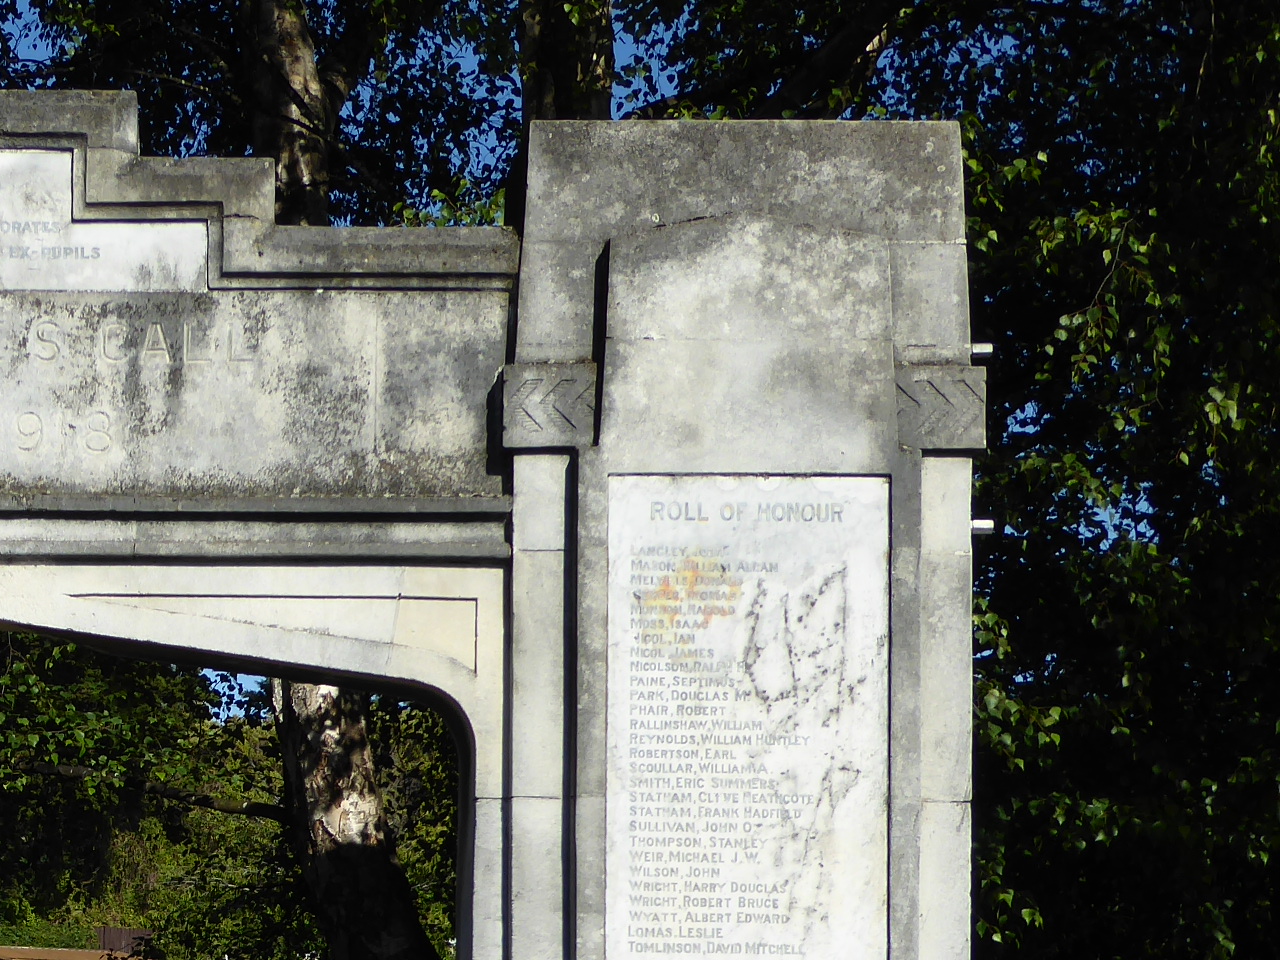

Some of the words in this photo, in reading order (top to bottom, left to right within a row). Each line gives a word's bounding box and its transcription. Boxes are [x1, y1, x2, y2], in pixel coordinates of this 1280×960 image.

[10, 246, 101, 260] EX-PUPILS
[100, 321, 255, 364] CALL
[650, 502, 709, 521] ROLL
[720, 502, 748, 521] OF
[757, 502, 844, 523] HONOUR
[673, 647, 714, 659] JAMES
[630, 676, 671, 689] PAINE,
[630, 690, 669, 703] PARK,
[671, 691, 729, 702] DOUGLAS
[676, 704, 726, 716] ROBERT
[711, 719, 762, 731] WILLIAM
[630, 733, 700, 746] REYNOLDS,
[700, 734, 752, 745] WILLIAM
[756, 734, 811, 746] HUNTLEY
[630, 748, 703, 761] ROBERTSON,
[705, 749, 736, 760] EARL
[698, 762, 752, 774] WILLIAM
[629, 776, 674, 790] SMITH,
[676, 777, 705, 788] ERIC
[711, 777, 776, 789] SUMMERS
[743, 792, 814, 805] HEATHCOTE
[698, 806, 739, 818] FRANK
[629, 821, 700, 834] SULLIVAN,
[702, 821, 738, 833] JOHN
[709, 836, 768, 849] STANLEY
[629, 851, 668, 865] WEIR,
[669, 851, 725, 863] MICHAEL
[629, 866, 684, 879] WILSON,
[686, 866, 720, 878] JOHN
[629, 880, 682, 894] WRIGHT,
[684, 881, 727, 893] HARRY
[730, 881, 787, 894] DOUGLAS
[629, 895, 682, 909] WRIGHT,
[683, 895, 731, 908] ROBERT
[738, 896, 779, 909] BRUCE
[684, 911, 732, 923] ALBERT
[736, 911, 790, 924] EDWARD
[679, 926, 724, 938] LESLIE
[706, 941, 742, 954] DAVID
[745, 942, 806, 955] MITCHELL
